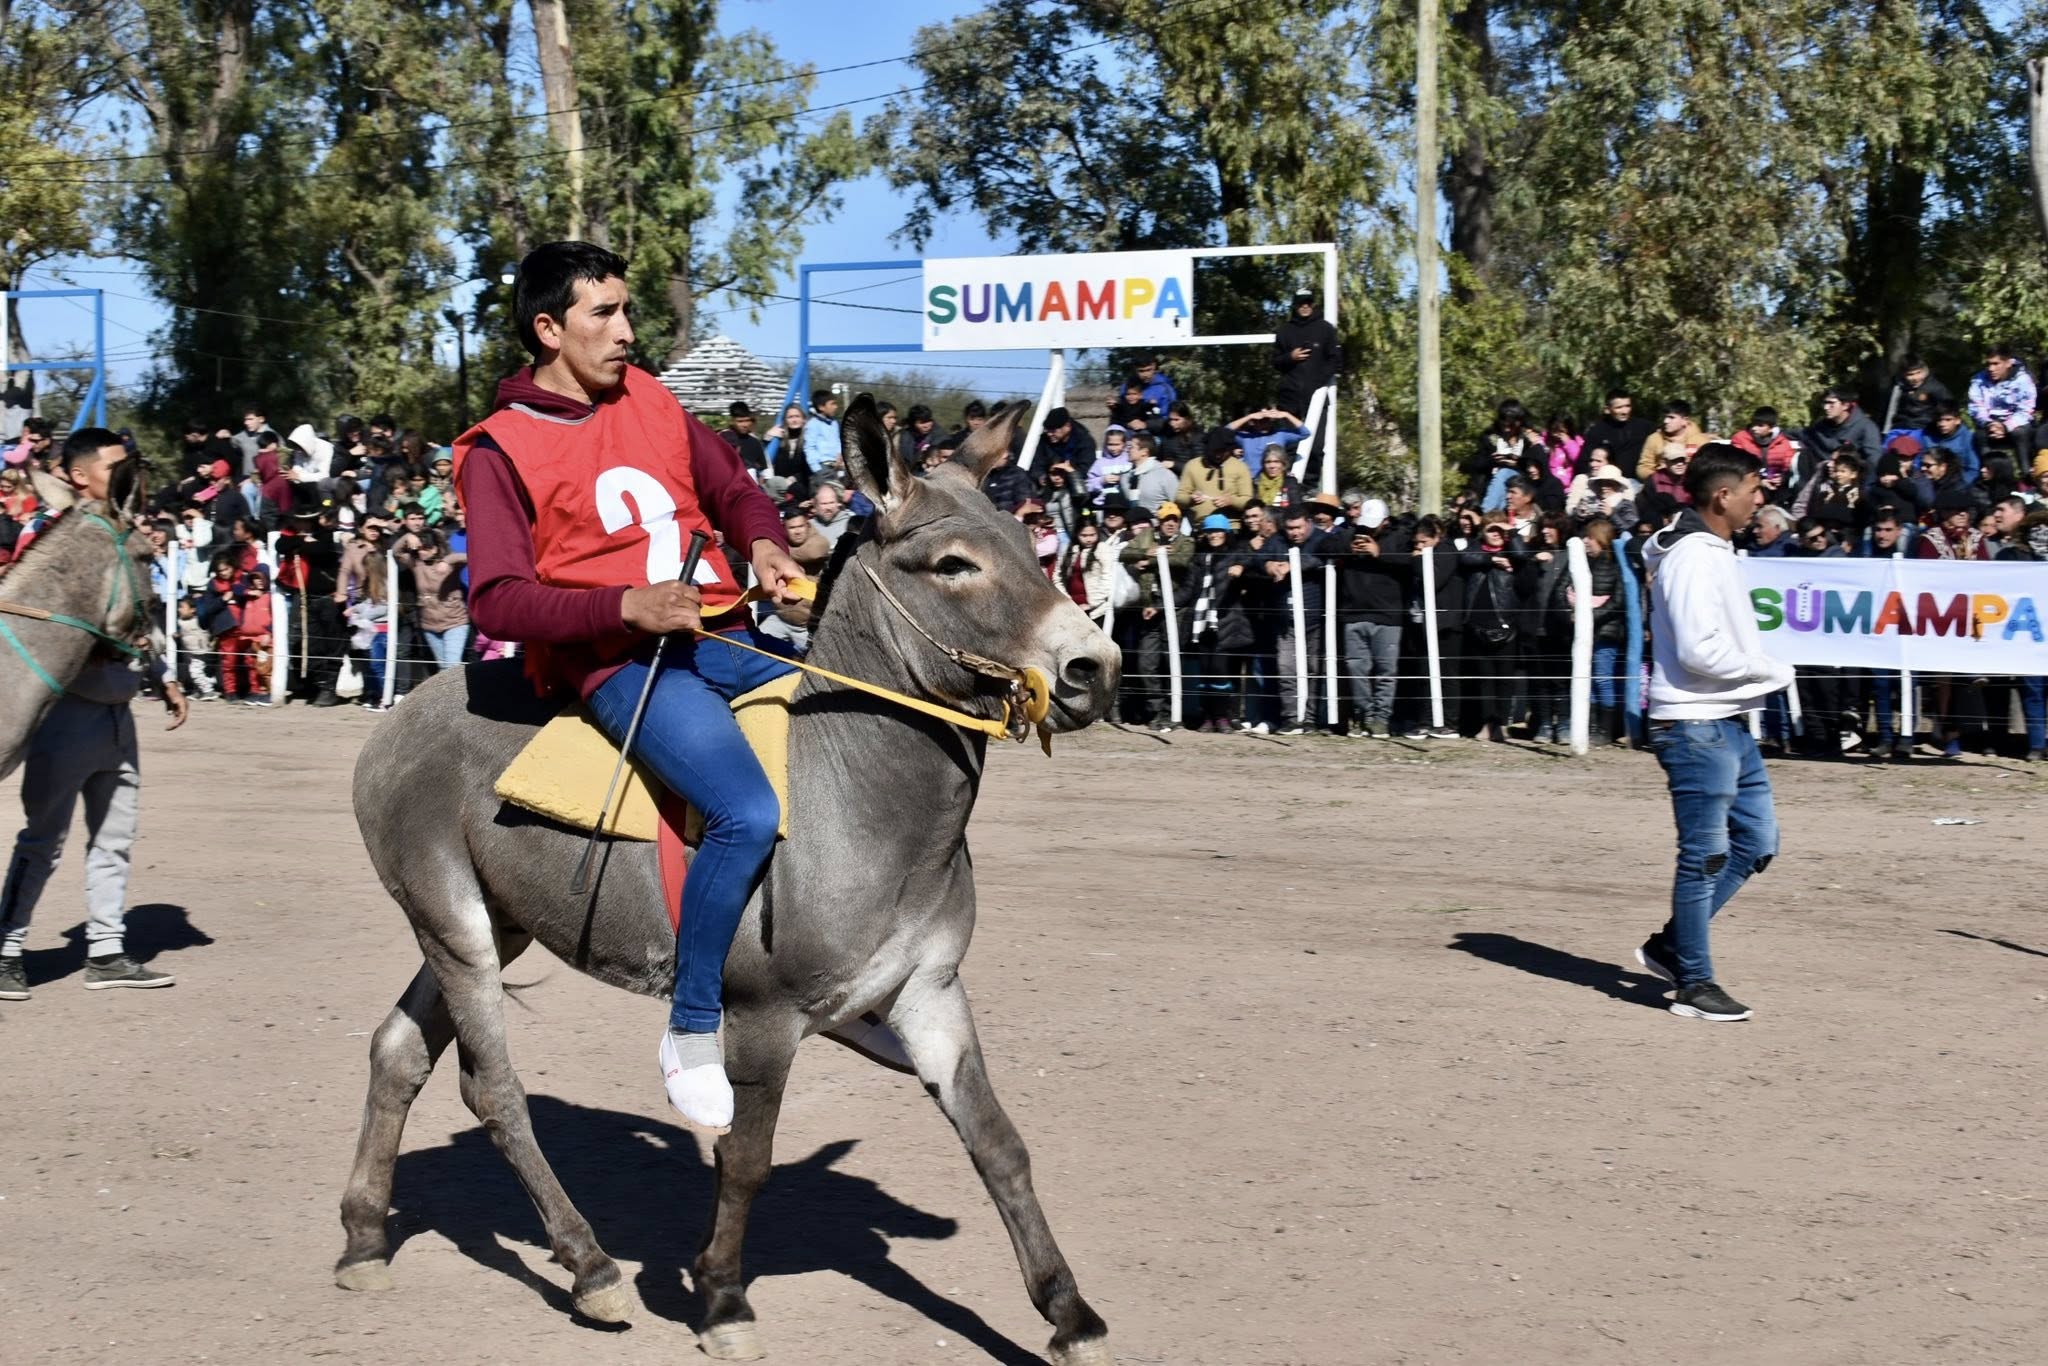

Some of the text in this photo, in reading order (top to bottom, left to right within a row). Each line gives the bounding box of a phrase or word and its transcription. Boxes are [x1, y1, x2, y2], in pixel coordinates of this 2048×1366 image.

[927, 277, 1189, 324] SUMAMPA
[595, 466, 721, 585] 2
[1750, 586, 2045, 642] SUMAMPA
